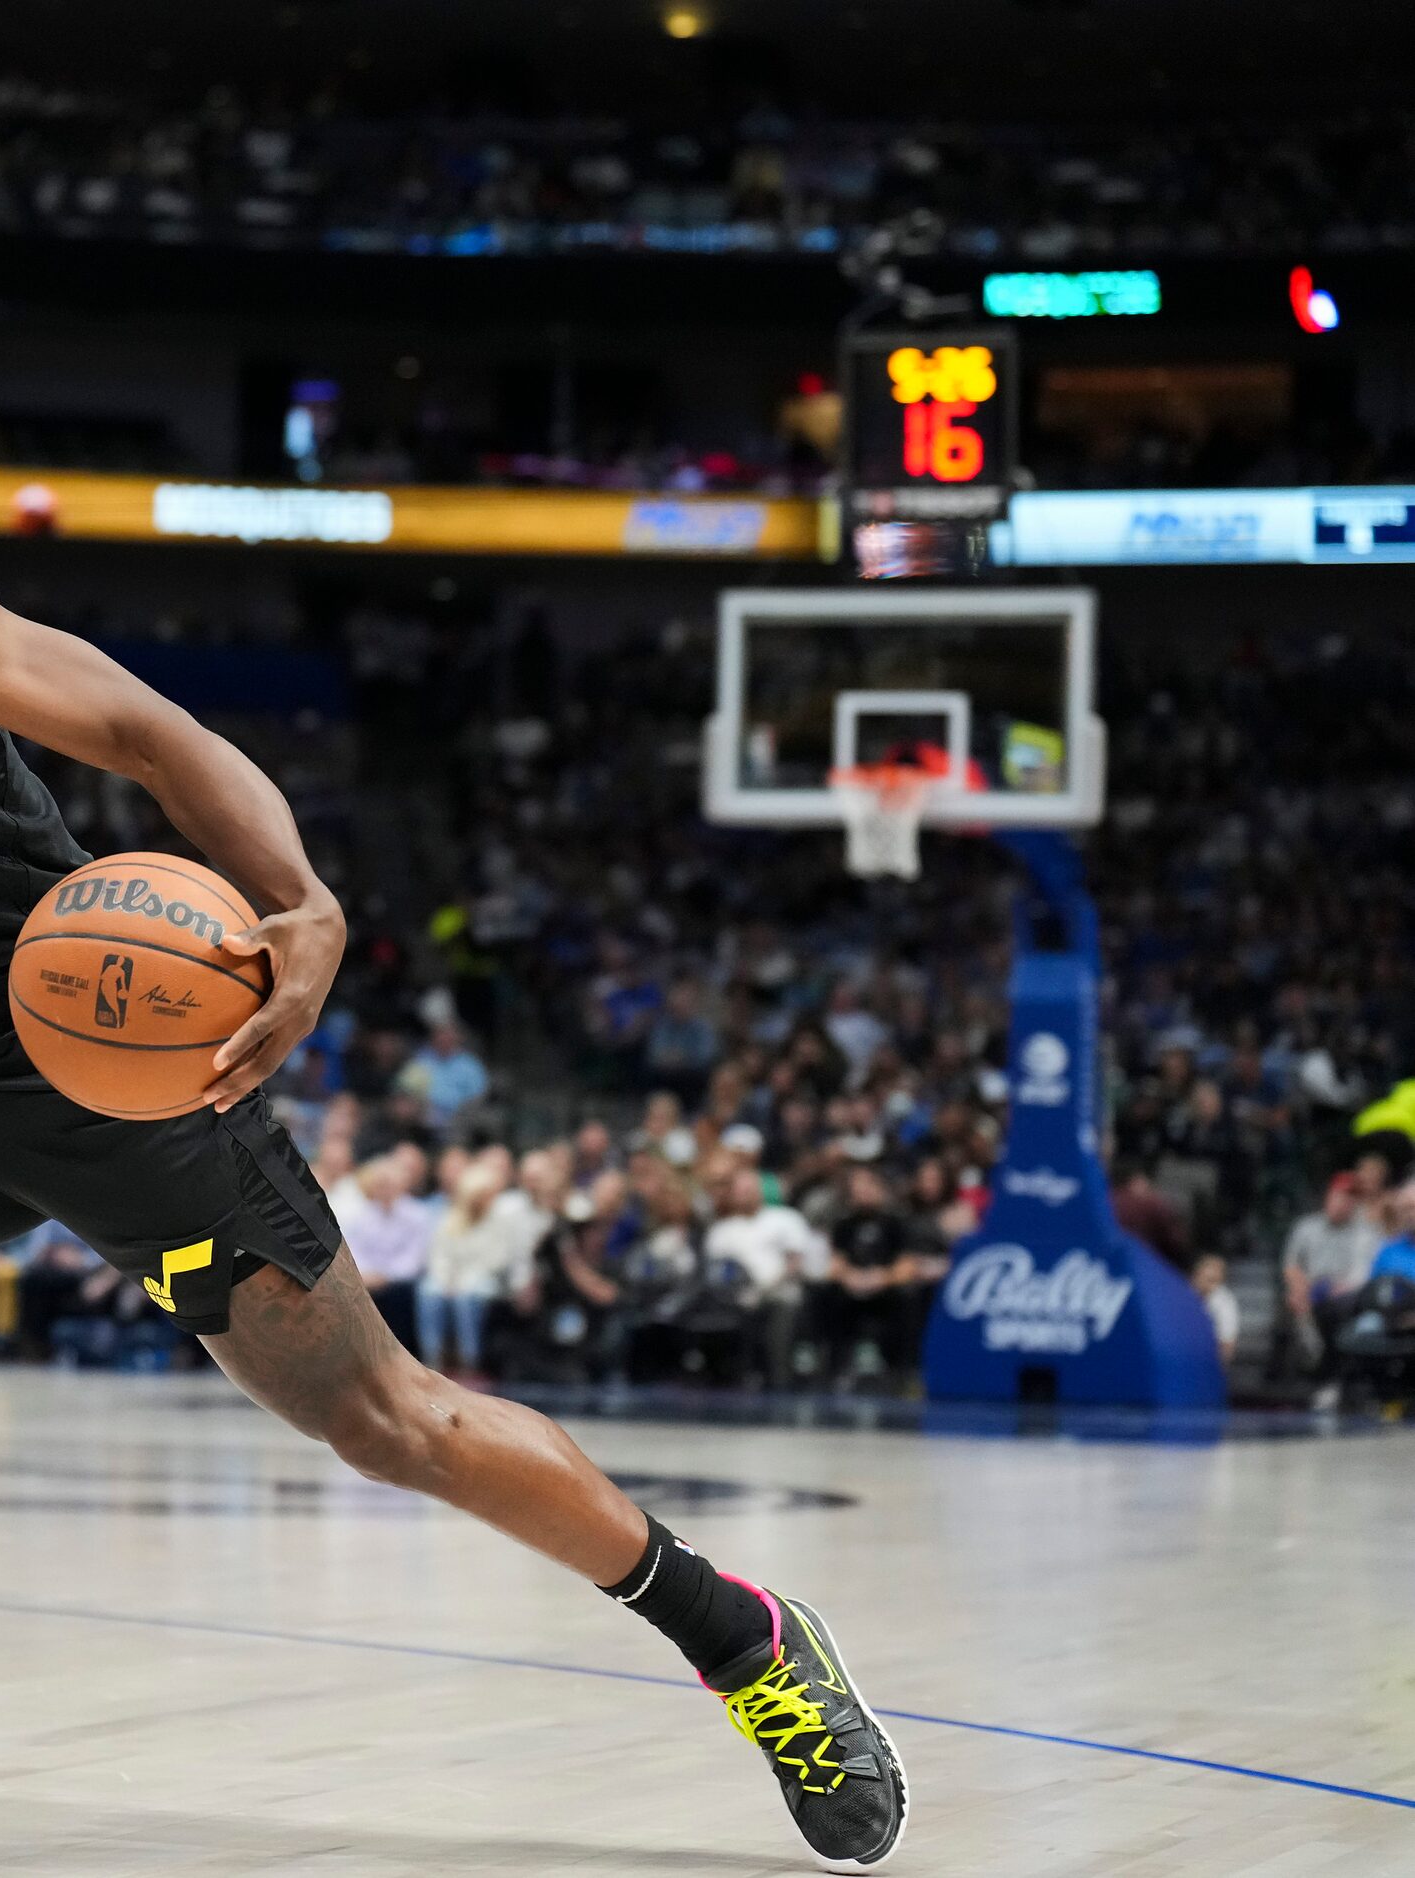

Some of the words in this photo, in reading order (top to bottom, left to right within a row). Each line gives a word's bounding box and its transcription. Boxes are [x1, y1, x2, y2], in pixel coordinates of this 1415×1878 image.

[904, 399, 984, 482] 16
[55, 877, 226, 946] Wilson
[944, 1244, 1132, 1341] Bally
